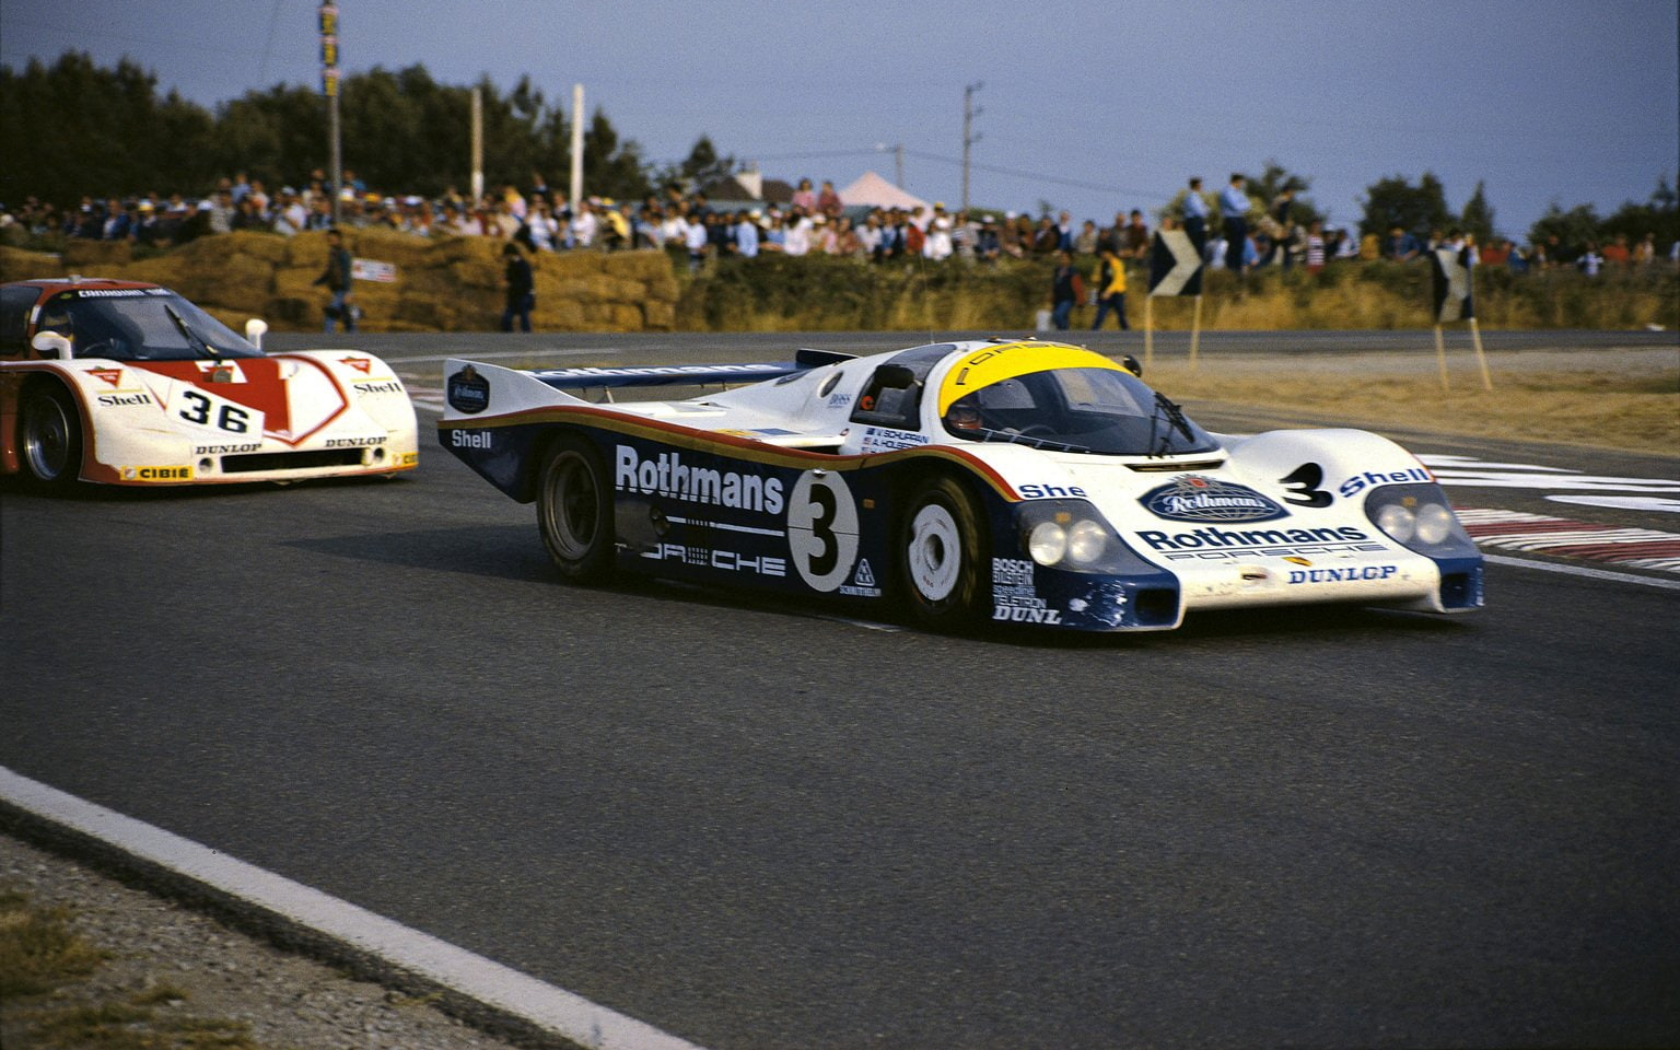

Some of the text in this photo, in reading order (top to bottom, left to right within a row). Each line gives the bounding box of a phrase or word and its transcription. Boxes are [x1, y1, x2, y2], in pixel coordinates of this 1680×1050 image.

[353, 382, 402, 394] Shell
[97, 394, 151, 406] Shell
[179, 390, 249, 433] 36
[195, 443, 263, 455] DUNLOP
[324, 436, 387, 448] DUNLOP
[452, 429, 491, 449] Shell
[615, 444, 784, 515] Rothmans
[1278, 462, 1334, 508] 3
[1339, 468, 1430, 499] Shell
[1162, 492, 1268, 514] Rothmans
[807, 483, 839, 577] 3
[1135, 525, 1370, 550] Rothmans
[1163, 544, 1389, 561] PORSCHE
[992, 557, 1034, 573] BOSCH
[1288, 565, 1398, 585] DUNLOP
